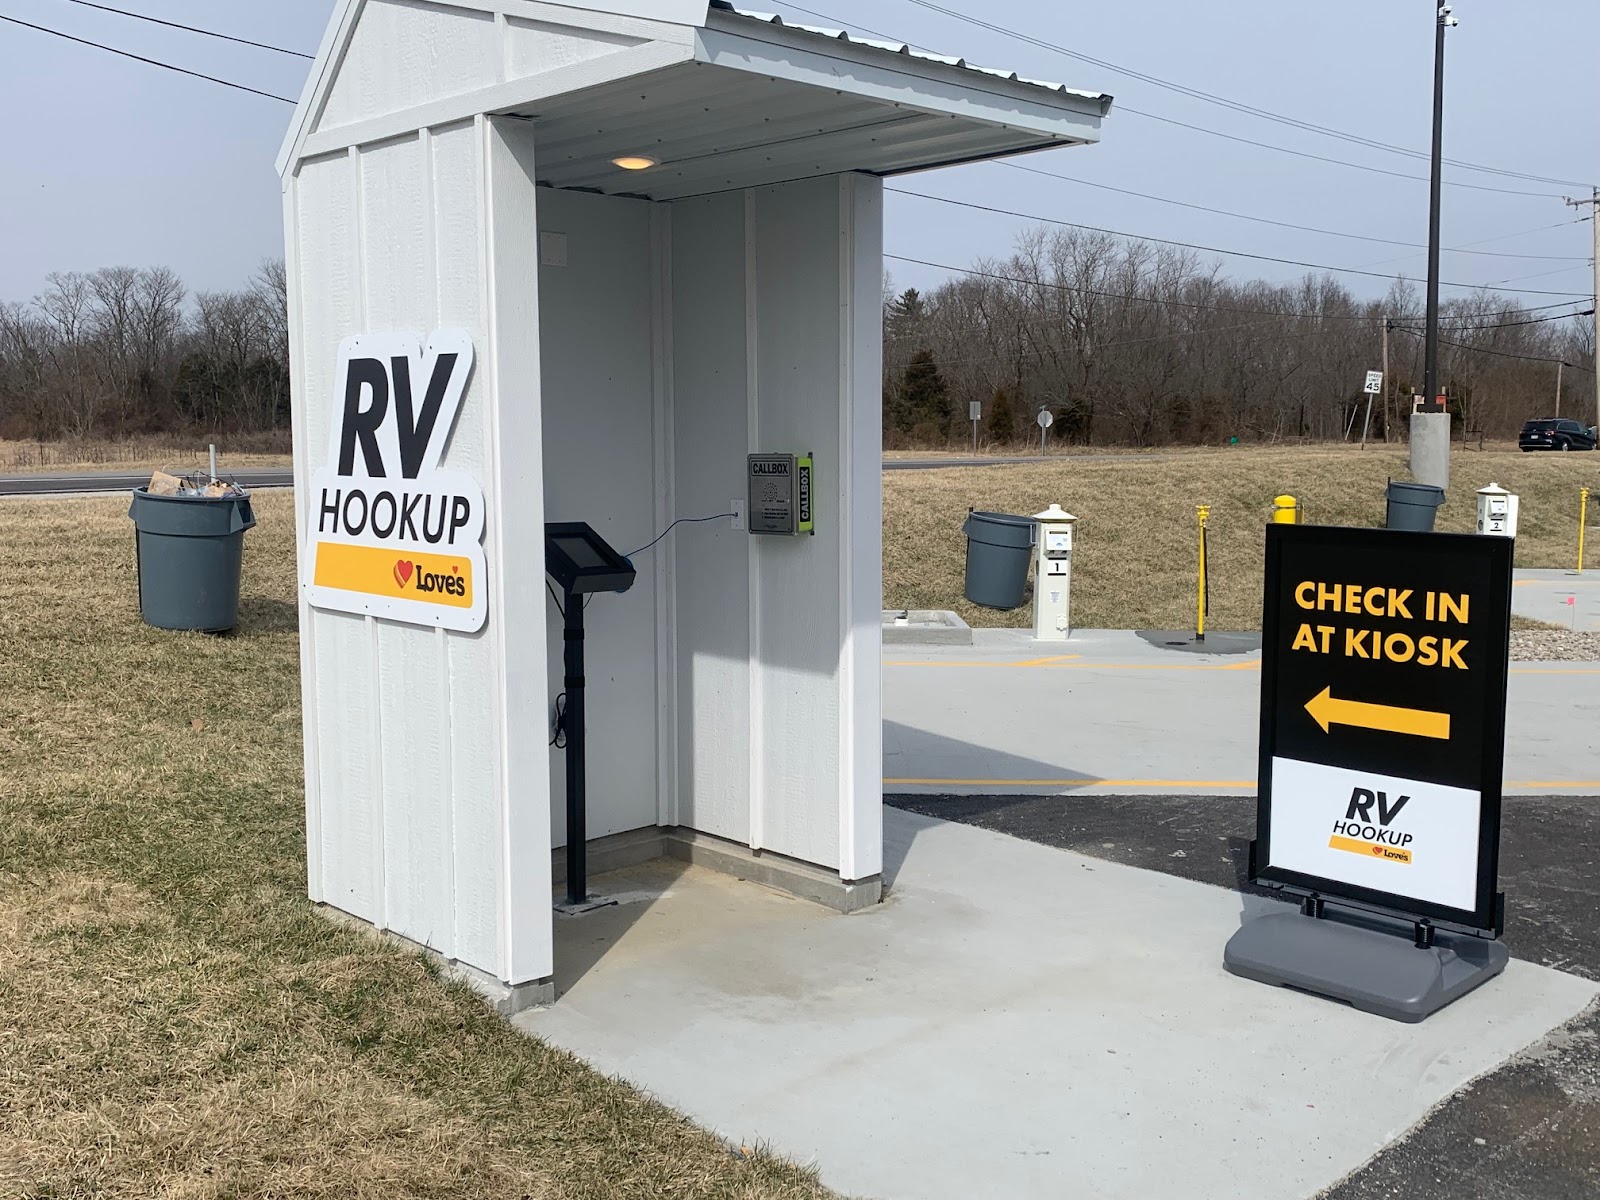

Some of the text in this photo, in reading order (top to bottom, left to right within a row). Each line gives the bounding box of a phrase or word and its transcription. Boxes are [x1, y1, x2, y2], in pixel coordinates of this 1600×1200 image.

[1366, 383, 1380, 391] 45
[337, 353, 459, 479] RV
[753, 463, 789, 474] CALLBOX
[800, 468, 810, 520] CALLBOX
[318, 488, 470, 545] HOOKUP
[1295, 581, 1470, 624] CHECK IN
[1292, 623, 1470, 670] AT KIOSK
[1345, 787, 1411, 826] RV
[1333, 820, 1413, 846] HOOKUP
